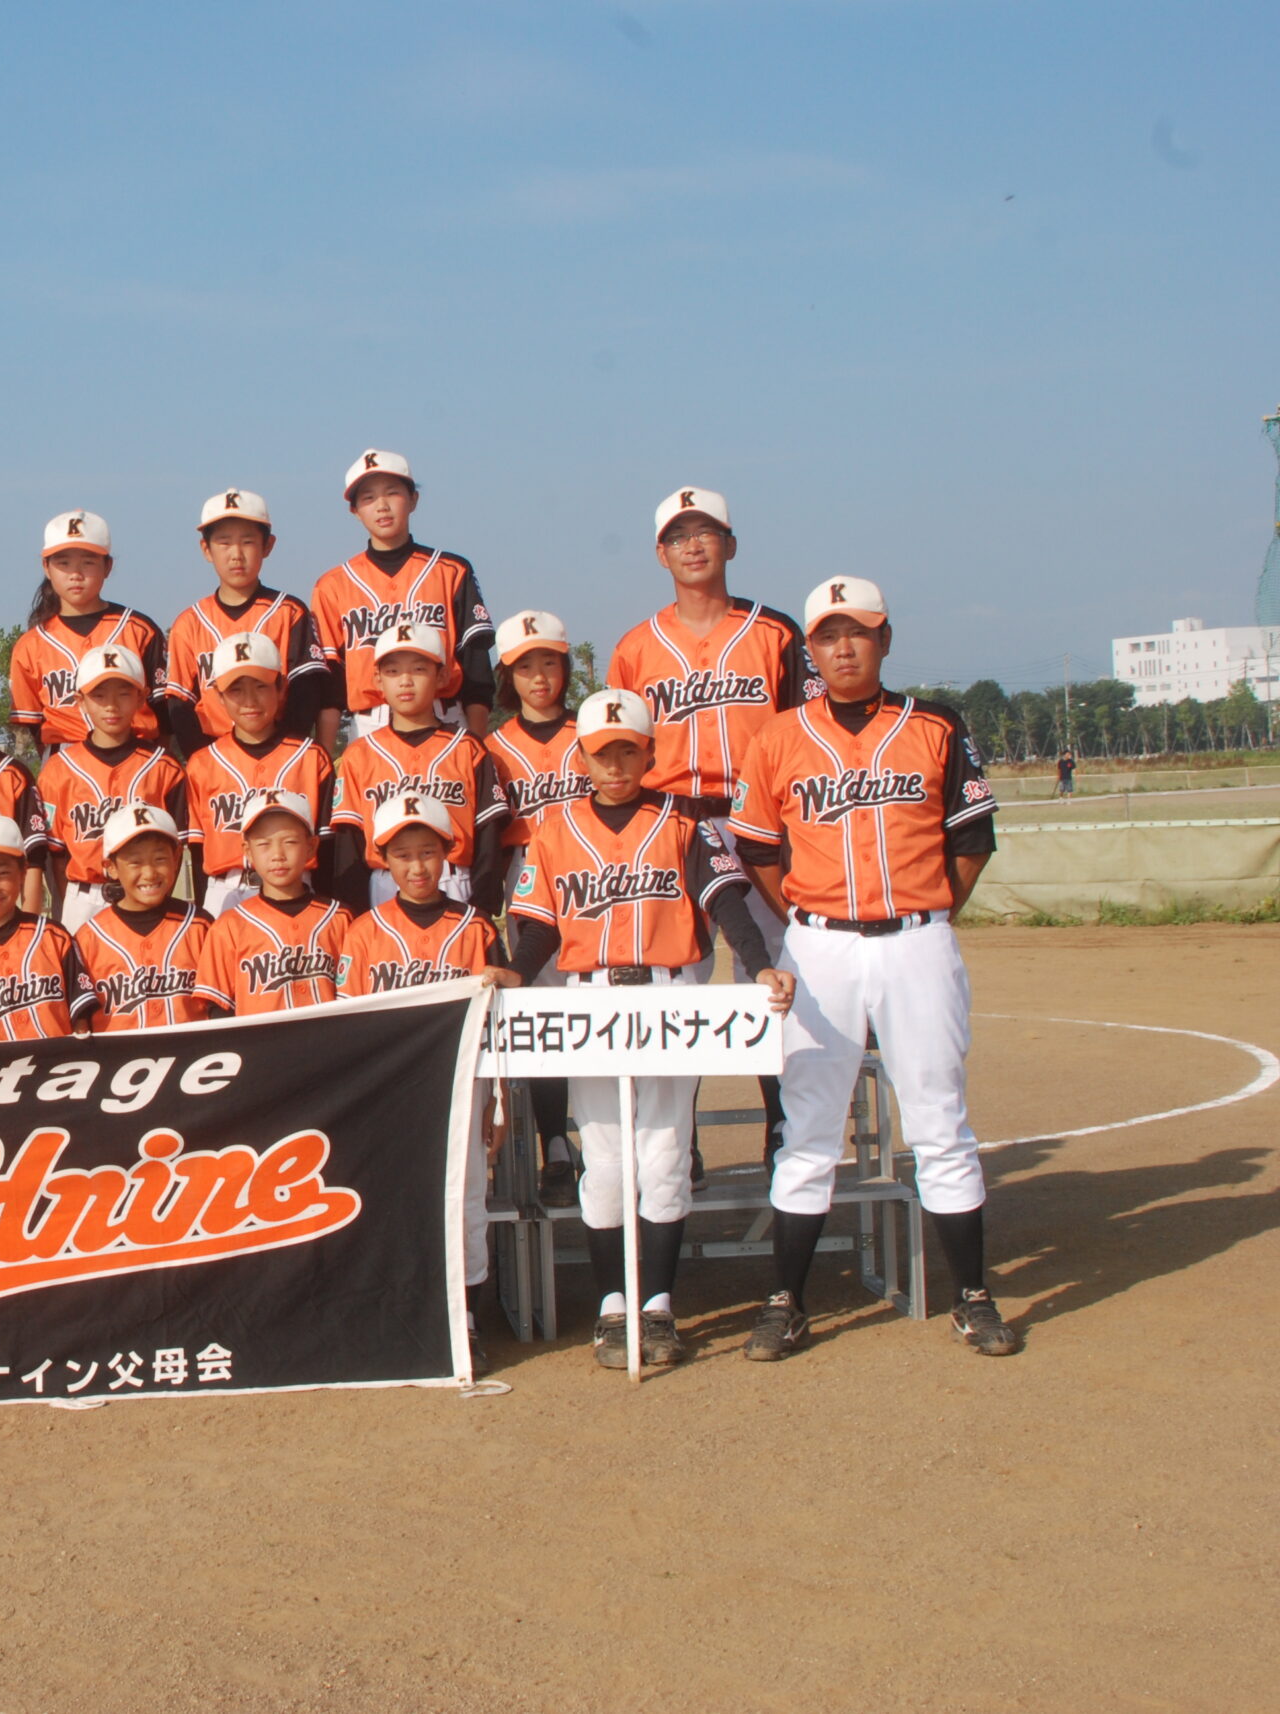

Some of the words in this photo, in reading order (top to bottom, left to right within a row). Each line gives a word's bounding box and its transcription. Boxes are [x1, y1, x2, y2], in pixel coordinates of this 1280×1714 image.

[364, 453, 379, 471] K
[225, 493, 240, 510] K
[680, 491, 696, 510] K
[68, 518, 84, 536] K
[830, 583, 846, 605] K
[397, 625, 412, 643] K
[523, 617, 538, 637] K
[104, 653, 119, 669] K
[235, 643, 251, 663] K
[645, 670, 769, 724] Wildnine
[606, 703, 623, 724] K
[266, 790, 281, 806] K
[792, 768, 926, 824] Wildnine
[404, 797, 421, 817] K
[133, 808, 151, 827] K
[555, 863, 681, 920] Wildnine
[96, 966, 196, 1014] Wildnine
[480, 1010, 770, 1053] 北白石ワイルドナイン
